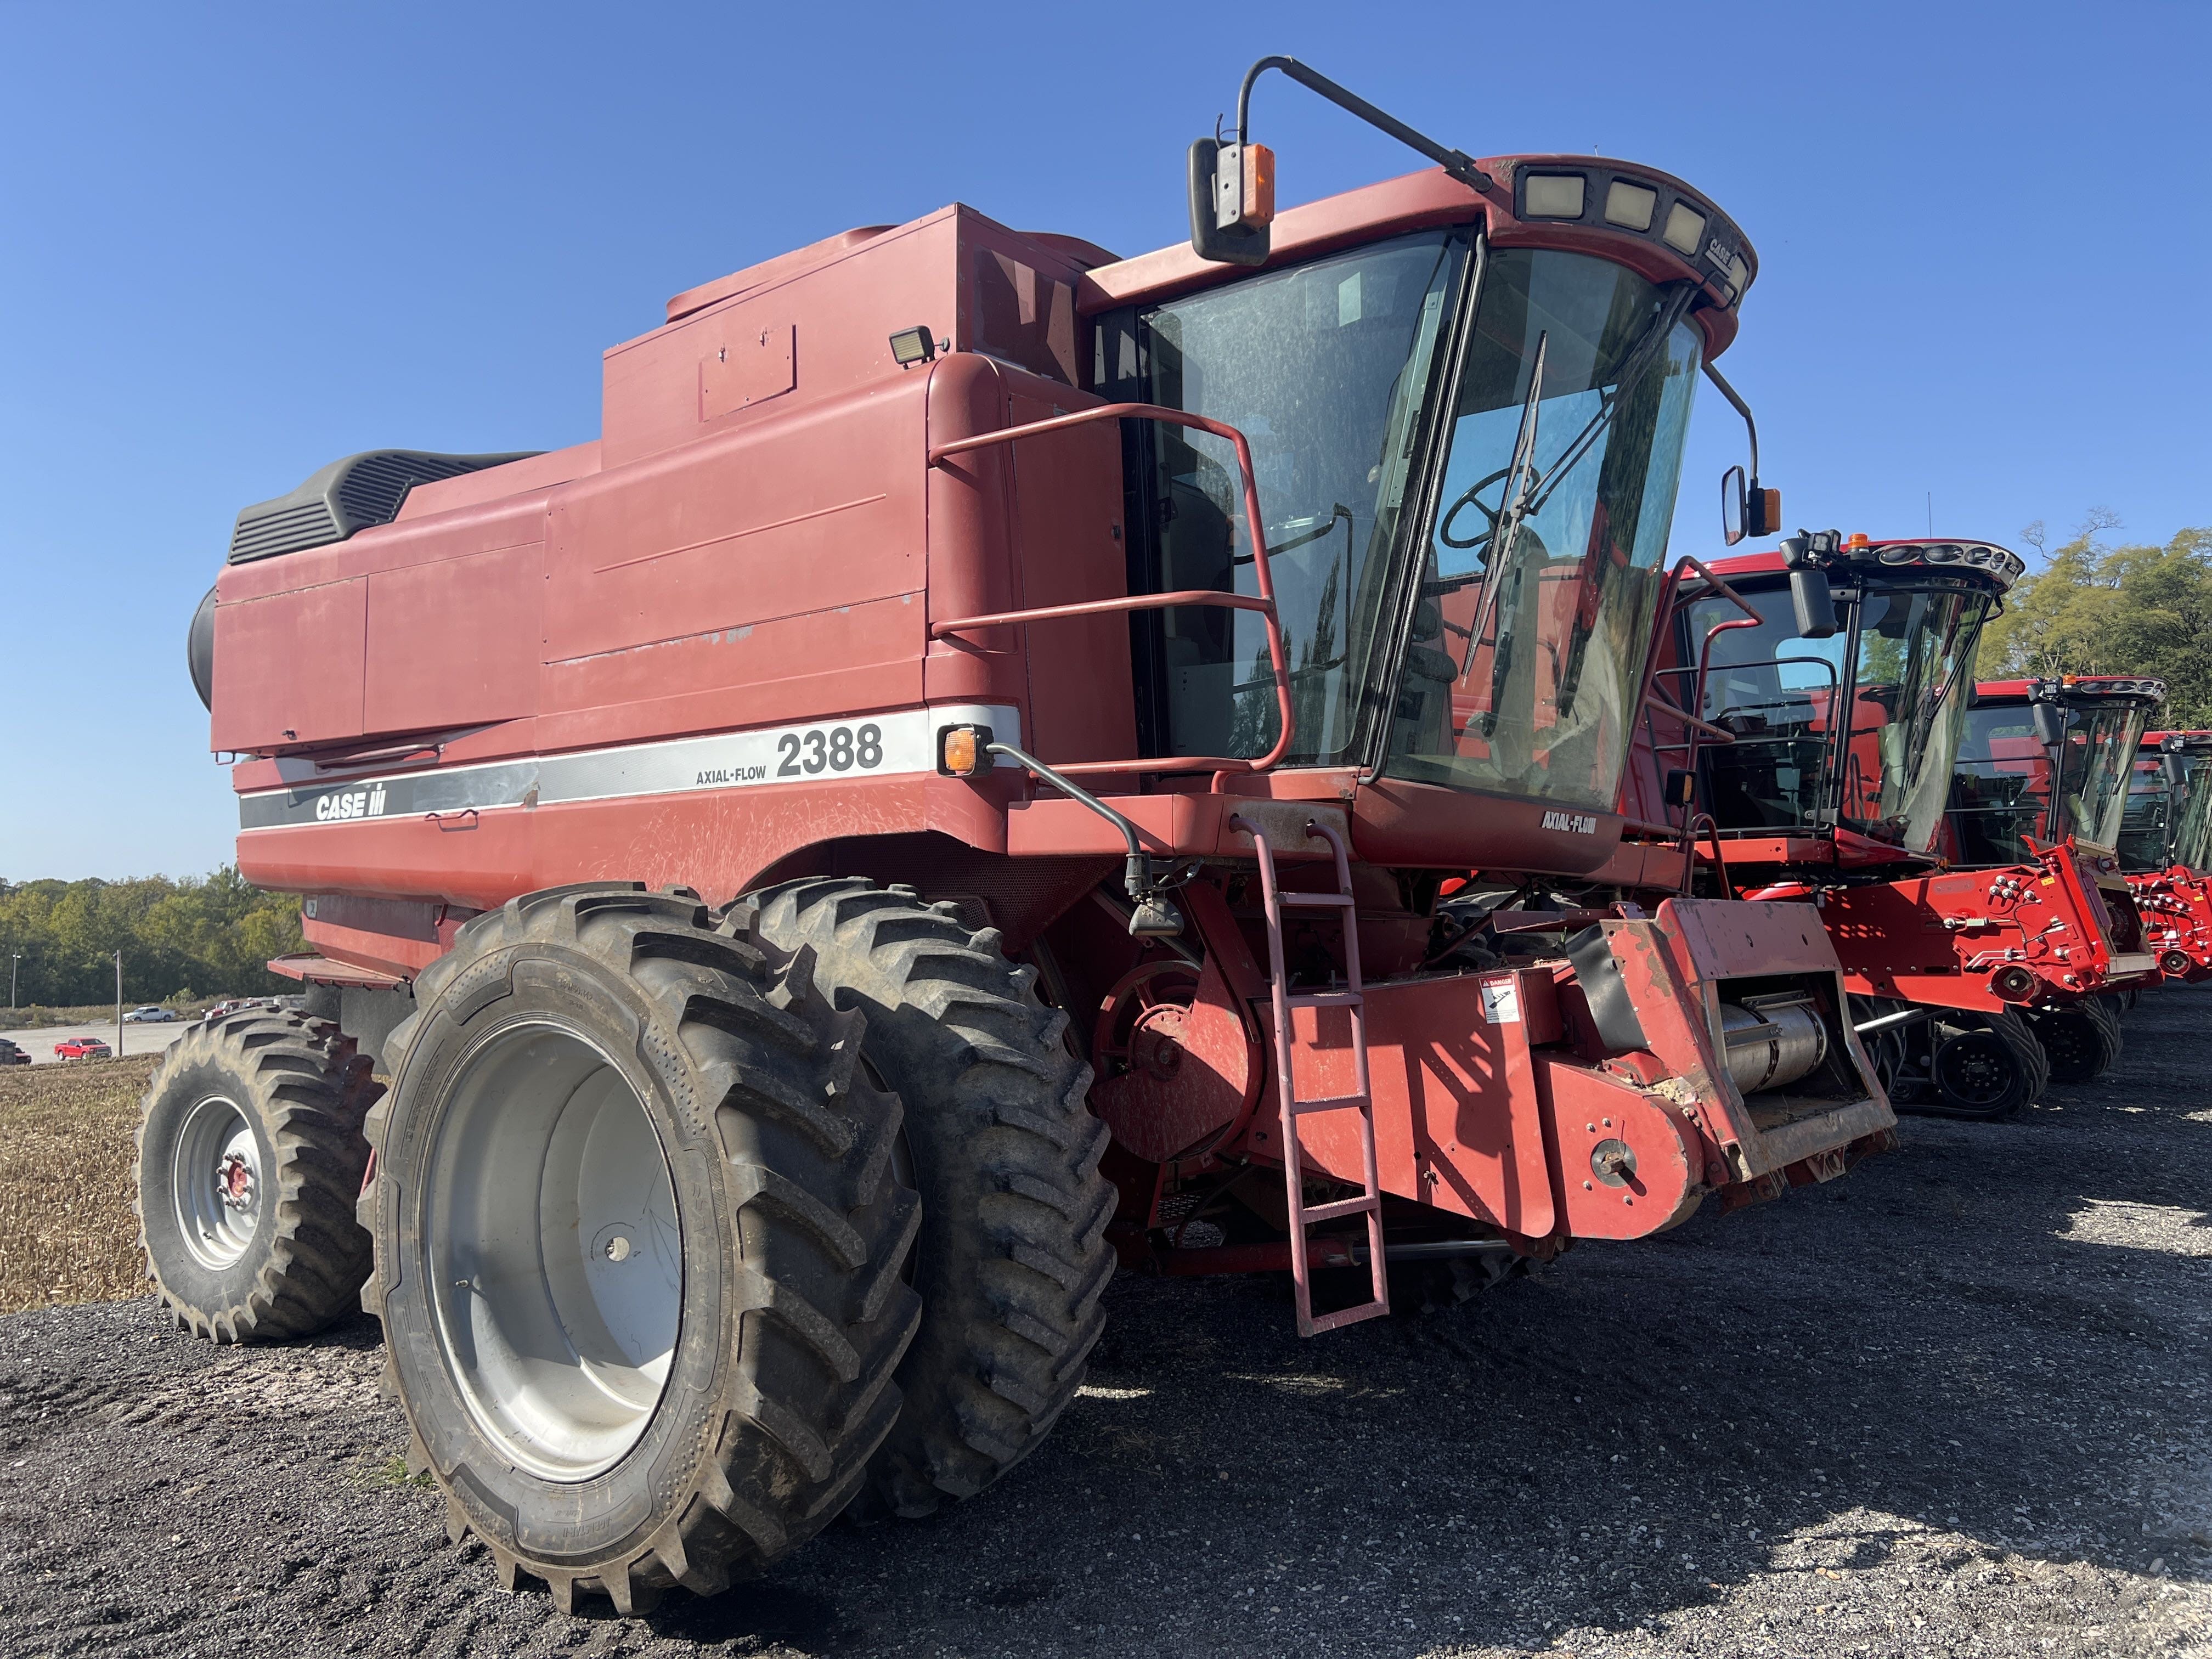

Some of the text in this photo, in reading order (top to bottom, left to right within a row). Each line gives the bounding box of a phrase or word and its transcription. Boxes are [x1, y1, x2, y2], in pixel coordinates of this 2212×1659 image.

[1710, 239, 1731, 264] CASE
[696, 723, 883, 785] AXIAL-FLOW 2388
[316, 792, 366, 820] CASE
[1542, 811, 1596, 834] AXIAL-FLOW
